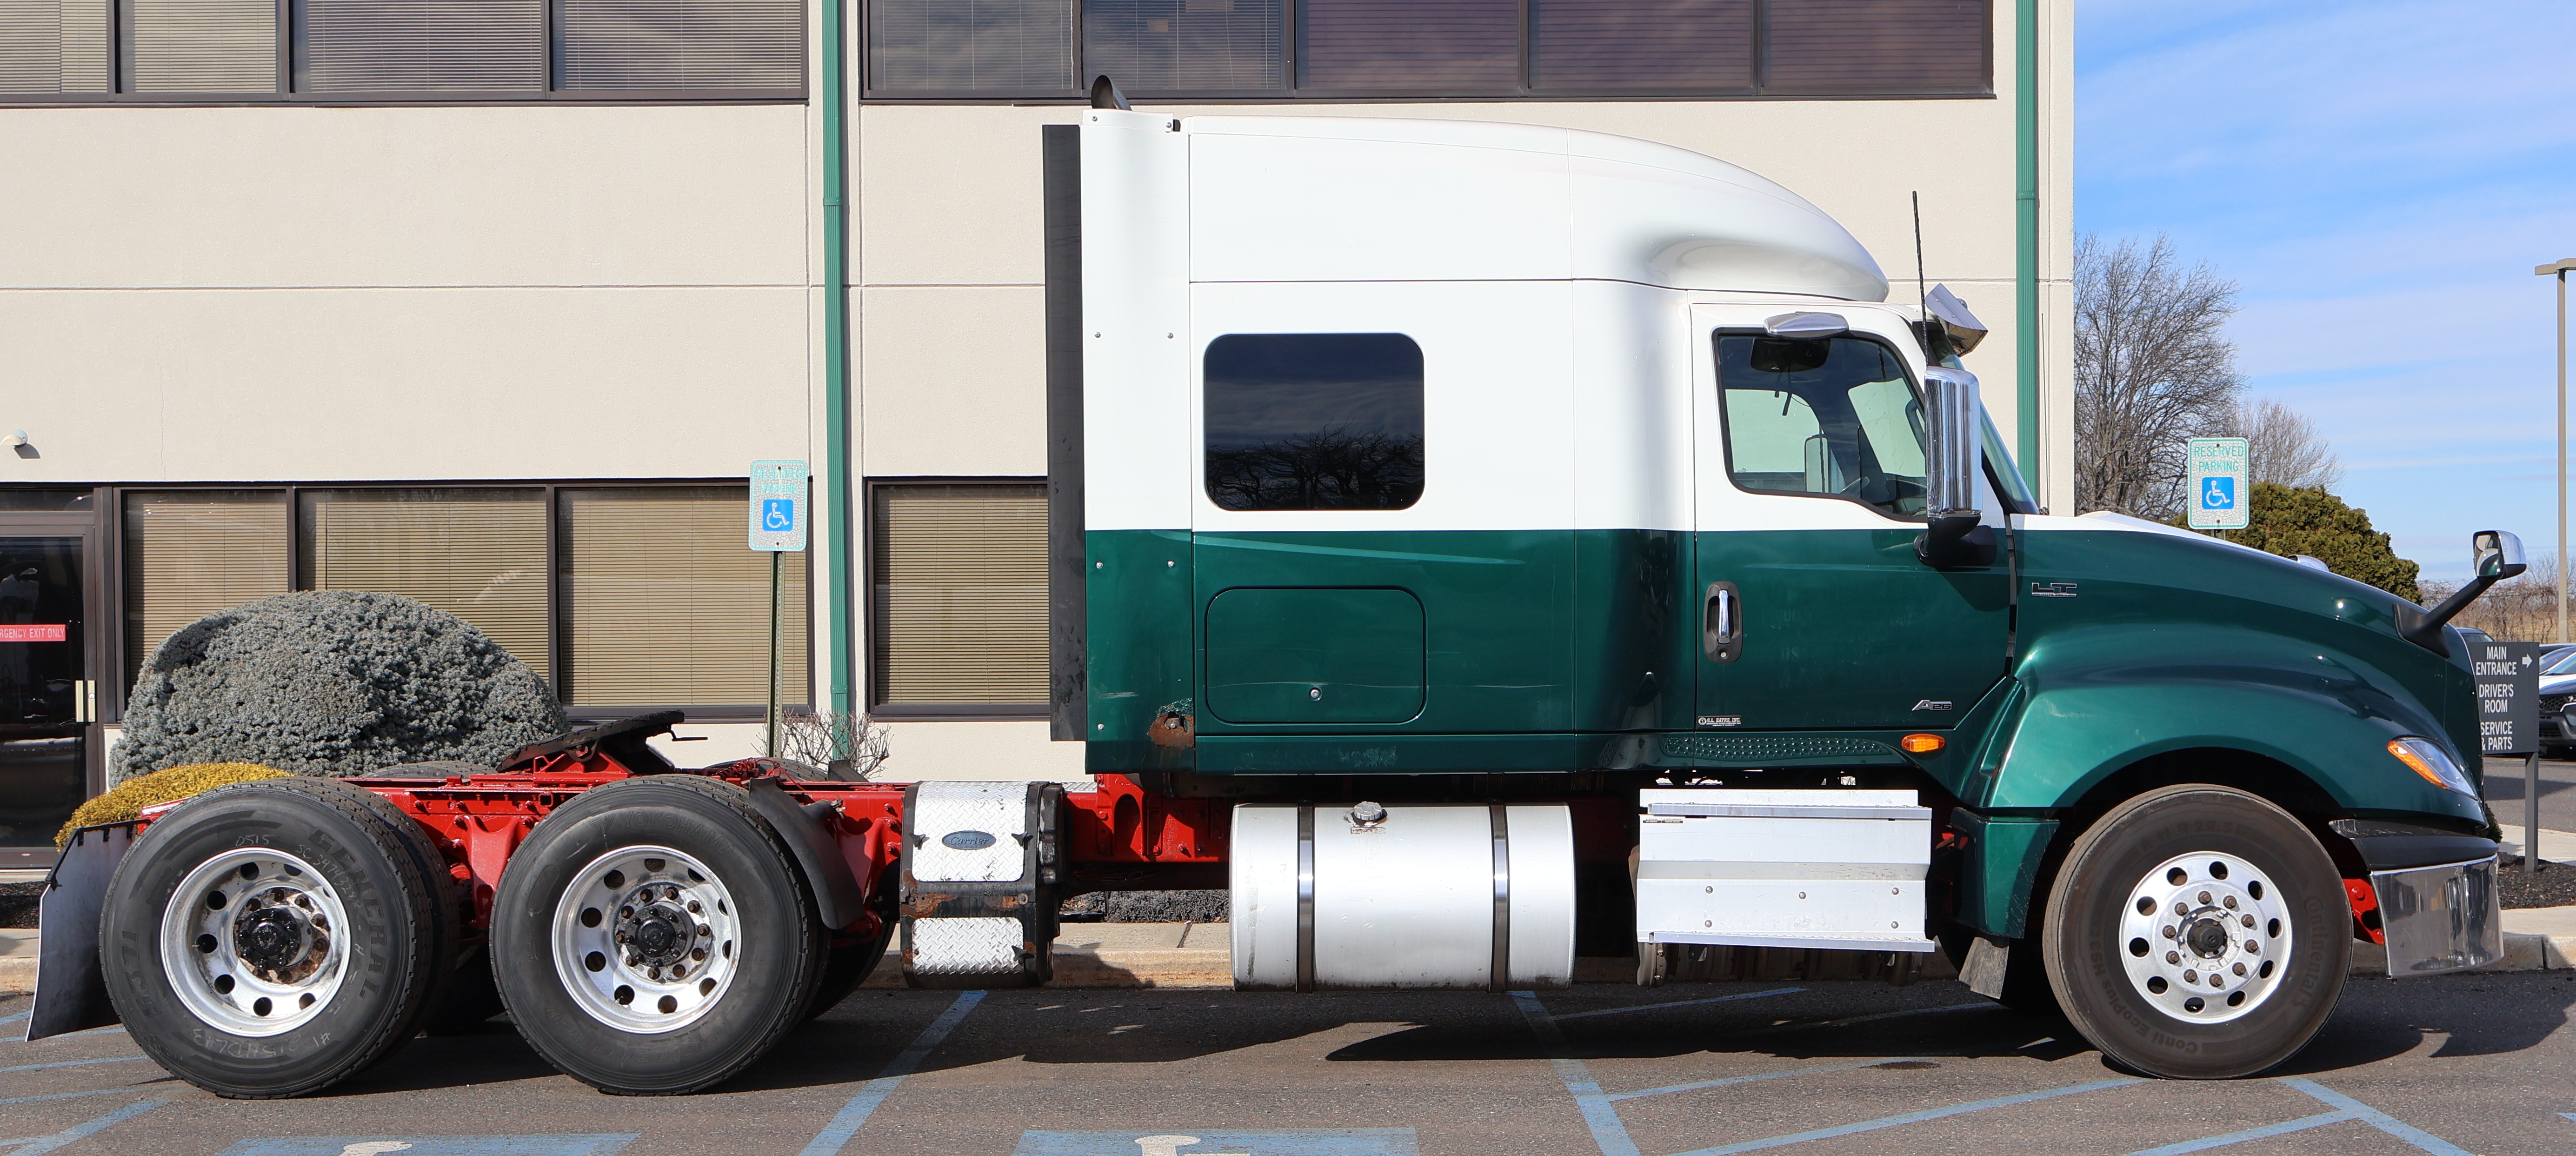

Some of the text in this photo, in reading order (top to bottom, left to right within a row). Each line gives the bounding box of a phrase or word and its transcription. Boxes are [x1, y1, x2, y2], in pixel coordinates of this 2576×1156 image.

[2195, 446, 2243, 457] RESERVED
[2199, 461, 2238, 472] PARKING
[760, 483, 799, 494] PARKING
[2031, 582, 2077, 593] LT
[29, 628, 45, 638] EXIT
[47, 628, 65, 638] ONLY
[2487, 646, 2507, 660] MAIN
[2476, 662, 2517, 675] ENTRANCE
[2479, 684, 2514, 697] DRIVER'S
[2485, 699, 2508, 713] ROOM
[2481, 721, 2513, 735] SERVICE
[2488, 736, 2512, 750] PARTS
[621, 810, 734, 856] YOKOHAMA
[308, 829, 388, 1001] GENERAL
[2300, 895, 2323, 996] Continental
[2089, 942, 2197, 1055] Conti EcoPlus HS3
